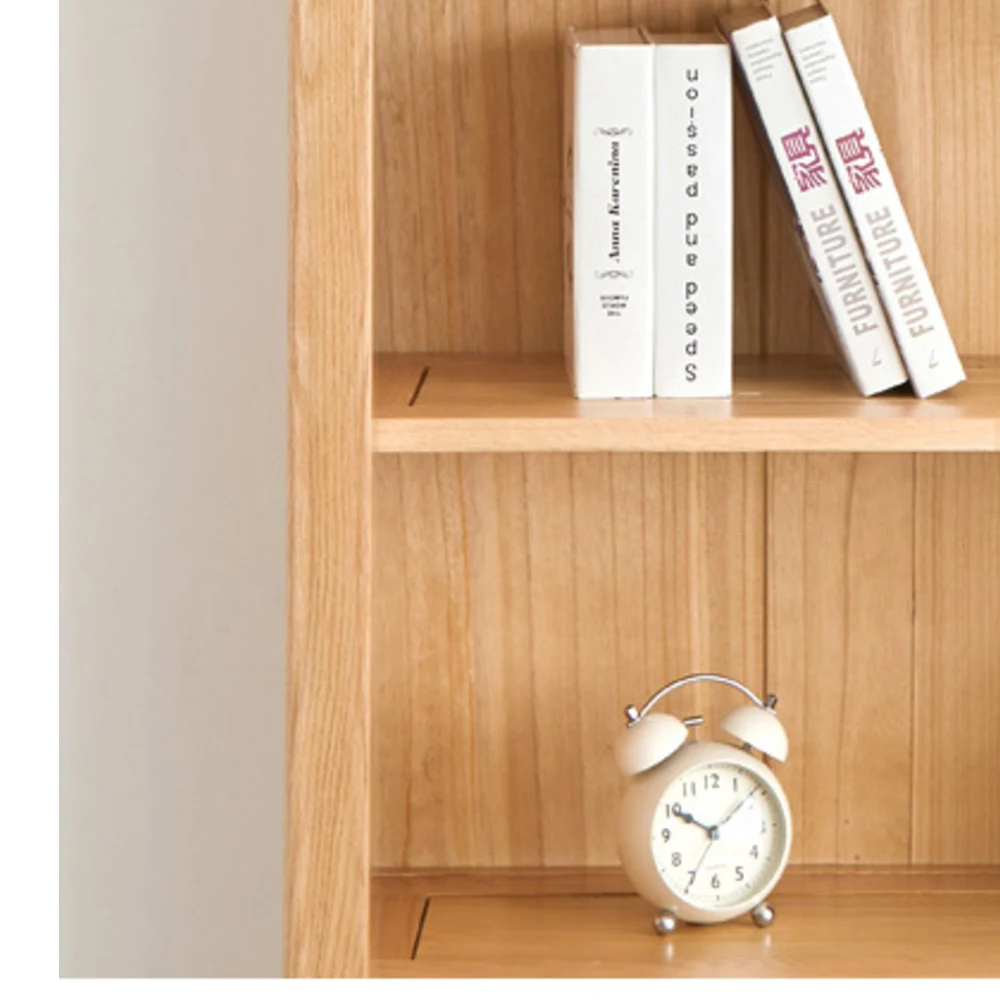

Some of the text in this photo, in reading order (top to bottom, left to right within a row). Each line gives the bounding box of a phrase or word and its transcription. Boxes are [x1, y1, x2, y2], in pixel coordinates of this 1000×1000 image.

[607, 140, 621, 263] Anna Karenina
[685, 68, 699, 383] Speed and passion
[810, 203, 878, 337] FURNITURE
[866, 205, 935, 338] FURNITURE
[683, 781, 697, 797] 11
[703, 773, 720, 790] 12
[732, 777, 739, 792] 1
[665, 802, 682, 818] 10
[661, 828, 671, 843] 9
[671, 852, 682, 867] 8
[750, 844, 759, 860] 4
[687, 870, 697, 886] 7
[710, 873, 720, 889] 6
[735, 866, 744, 881] 5
